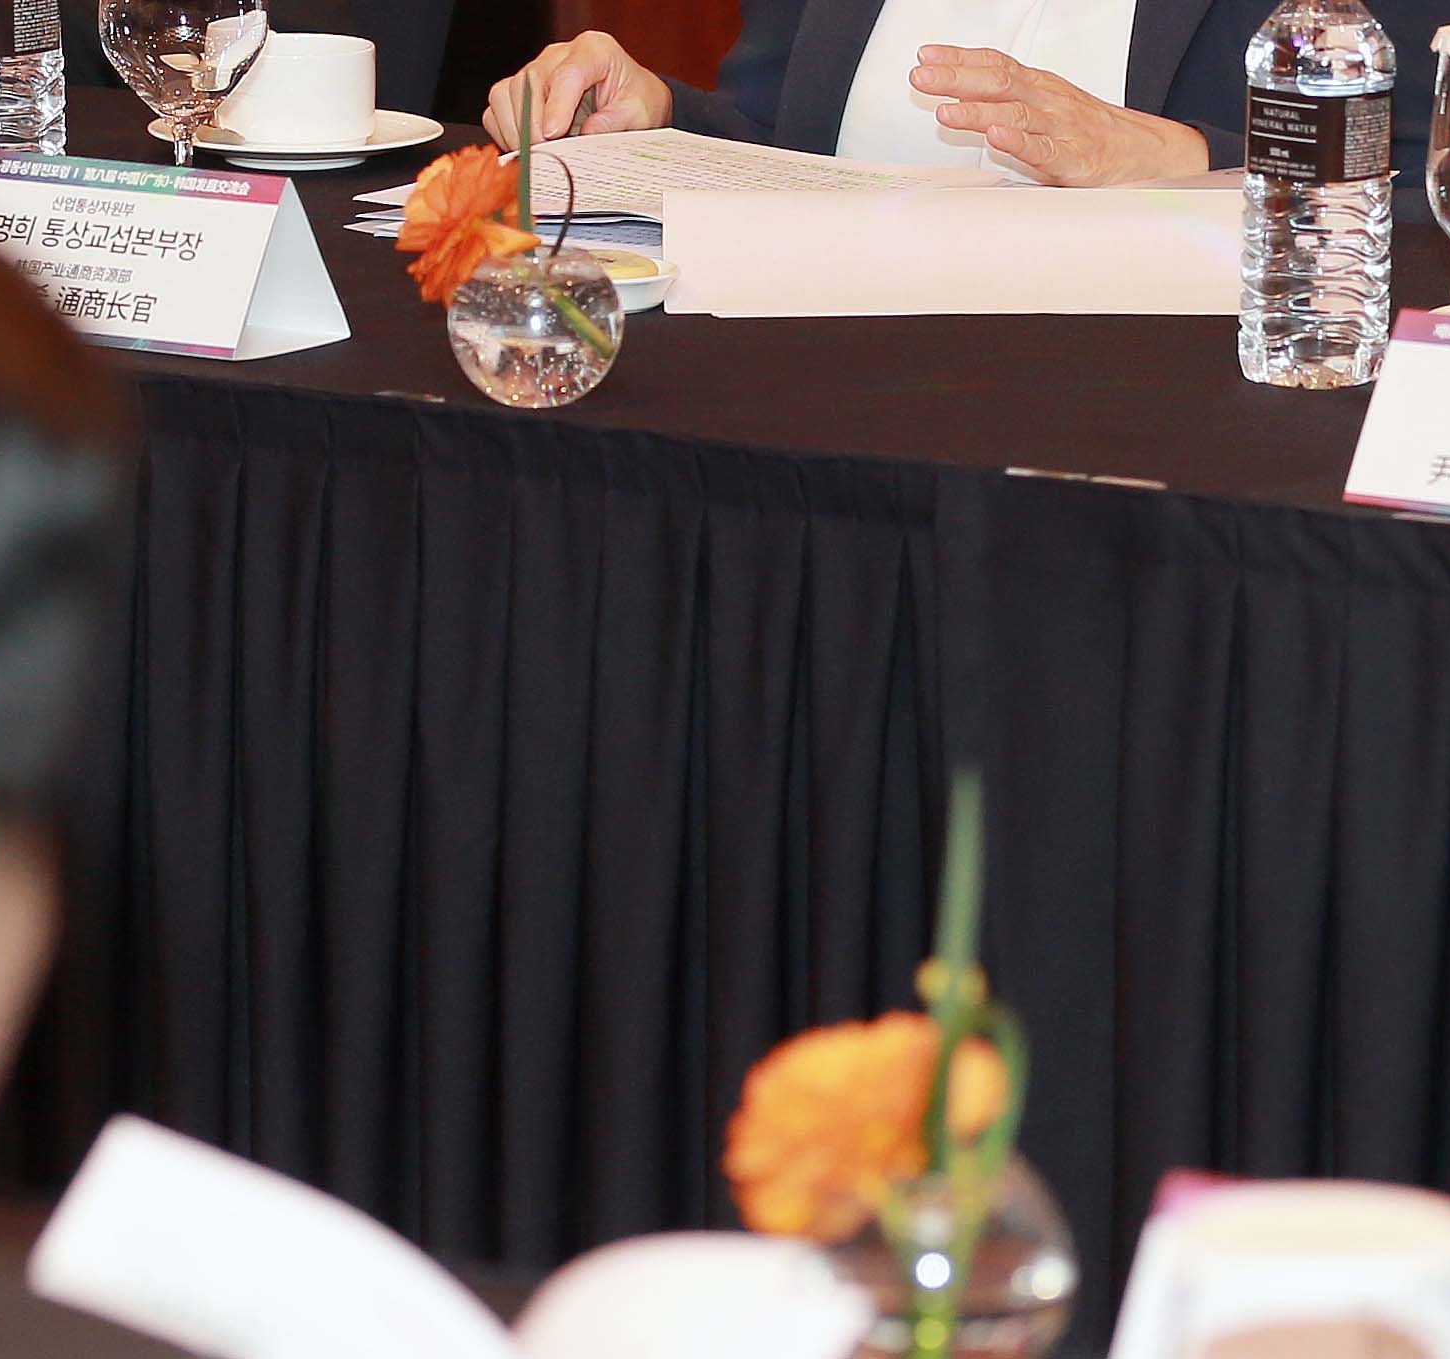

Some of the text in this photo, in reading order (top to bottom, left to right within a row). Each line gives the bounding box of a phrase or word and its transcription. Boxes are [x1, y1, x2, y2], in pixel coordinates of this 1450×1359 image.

[52, 195, 135, 217] 산업통상자원부
[41, 218, 203, 261] 통상교섭본부장
[54, 285, 157, 324] 通商长官
